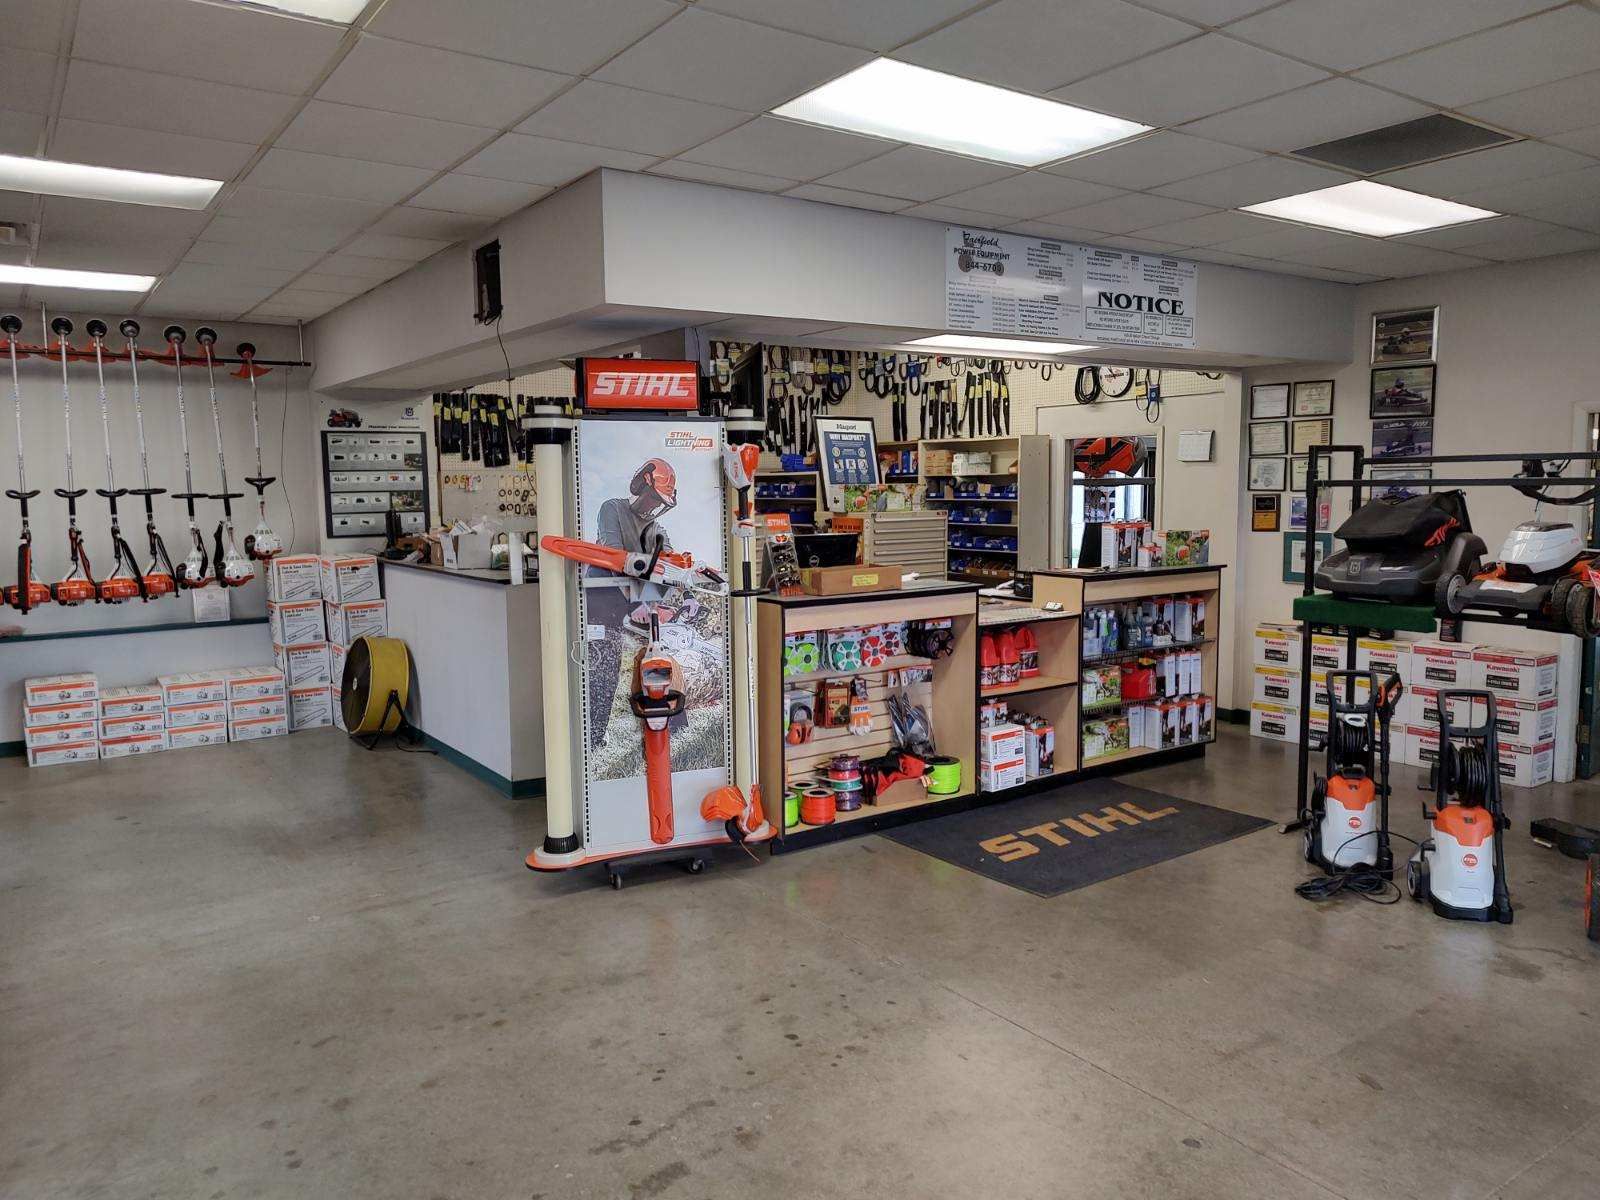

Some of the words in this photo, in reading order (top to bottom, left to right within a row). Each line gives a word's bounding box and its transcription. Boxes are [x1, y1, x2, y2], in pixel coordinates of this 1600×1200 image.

[953, 247, 976, 256] POWER
[977, 249, 1010, 260] EQUIPMENT
[1098, 291, 1184, 316] NOTICE
[592, 373, 690, 397] STIHL
[667, 438, 711, 448] LIGHTNING
[766, 518, 788, 526] STIHL
[1487, 664, 1520, 672] Kawasaki
[1262, 712, 1287, 720] Kawasaki
[978, 802, 1180, 863] STIHL
